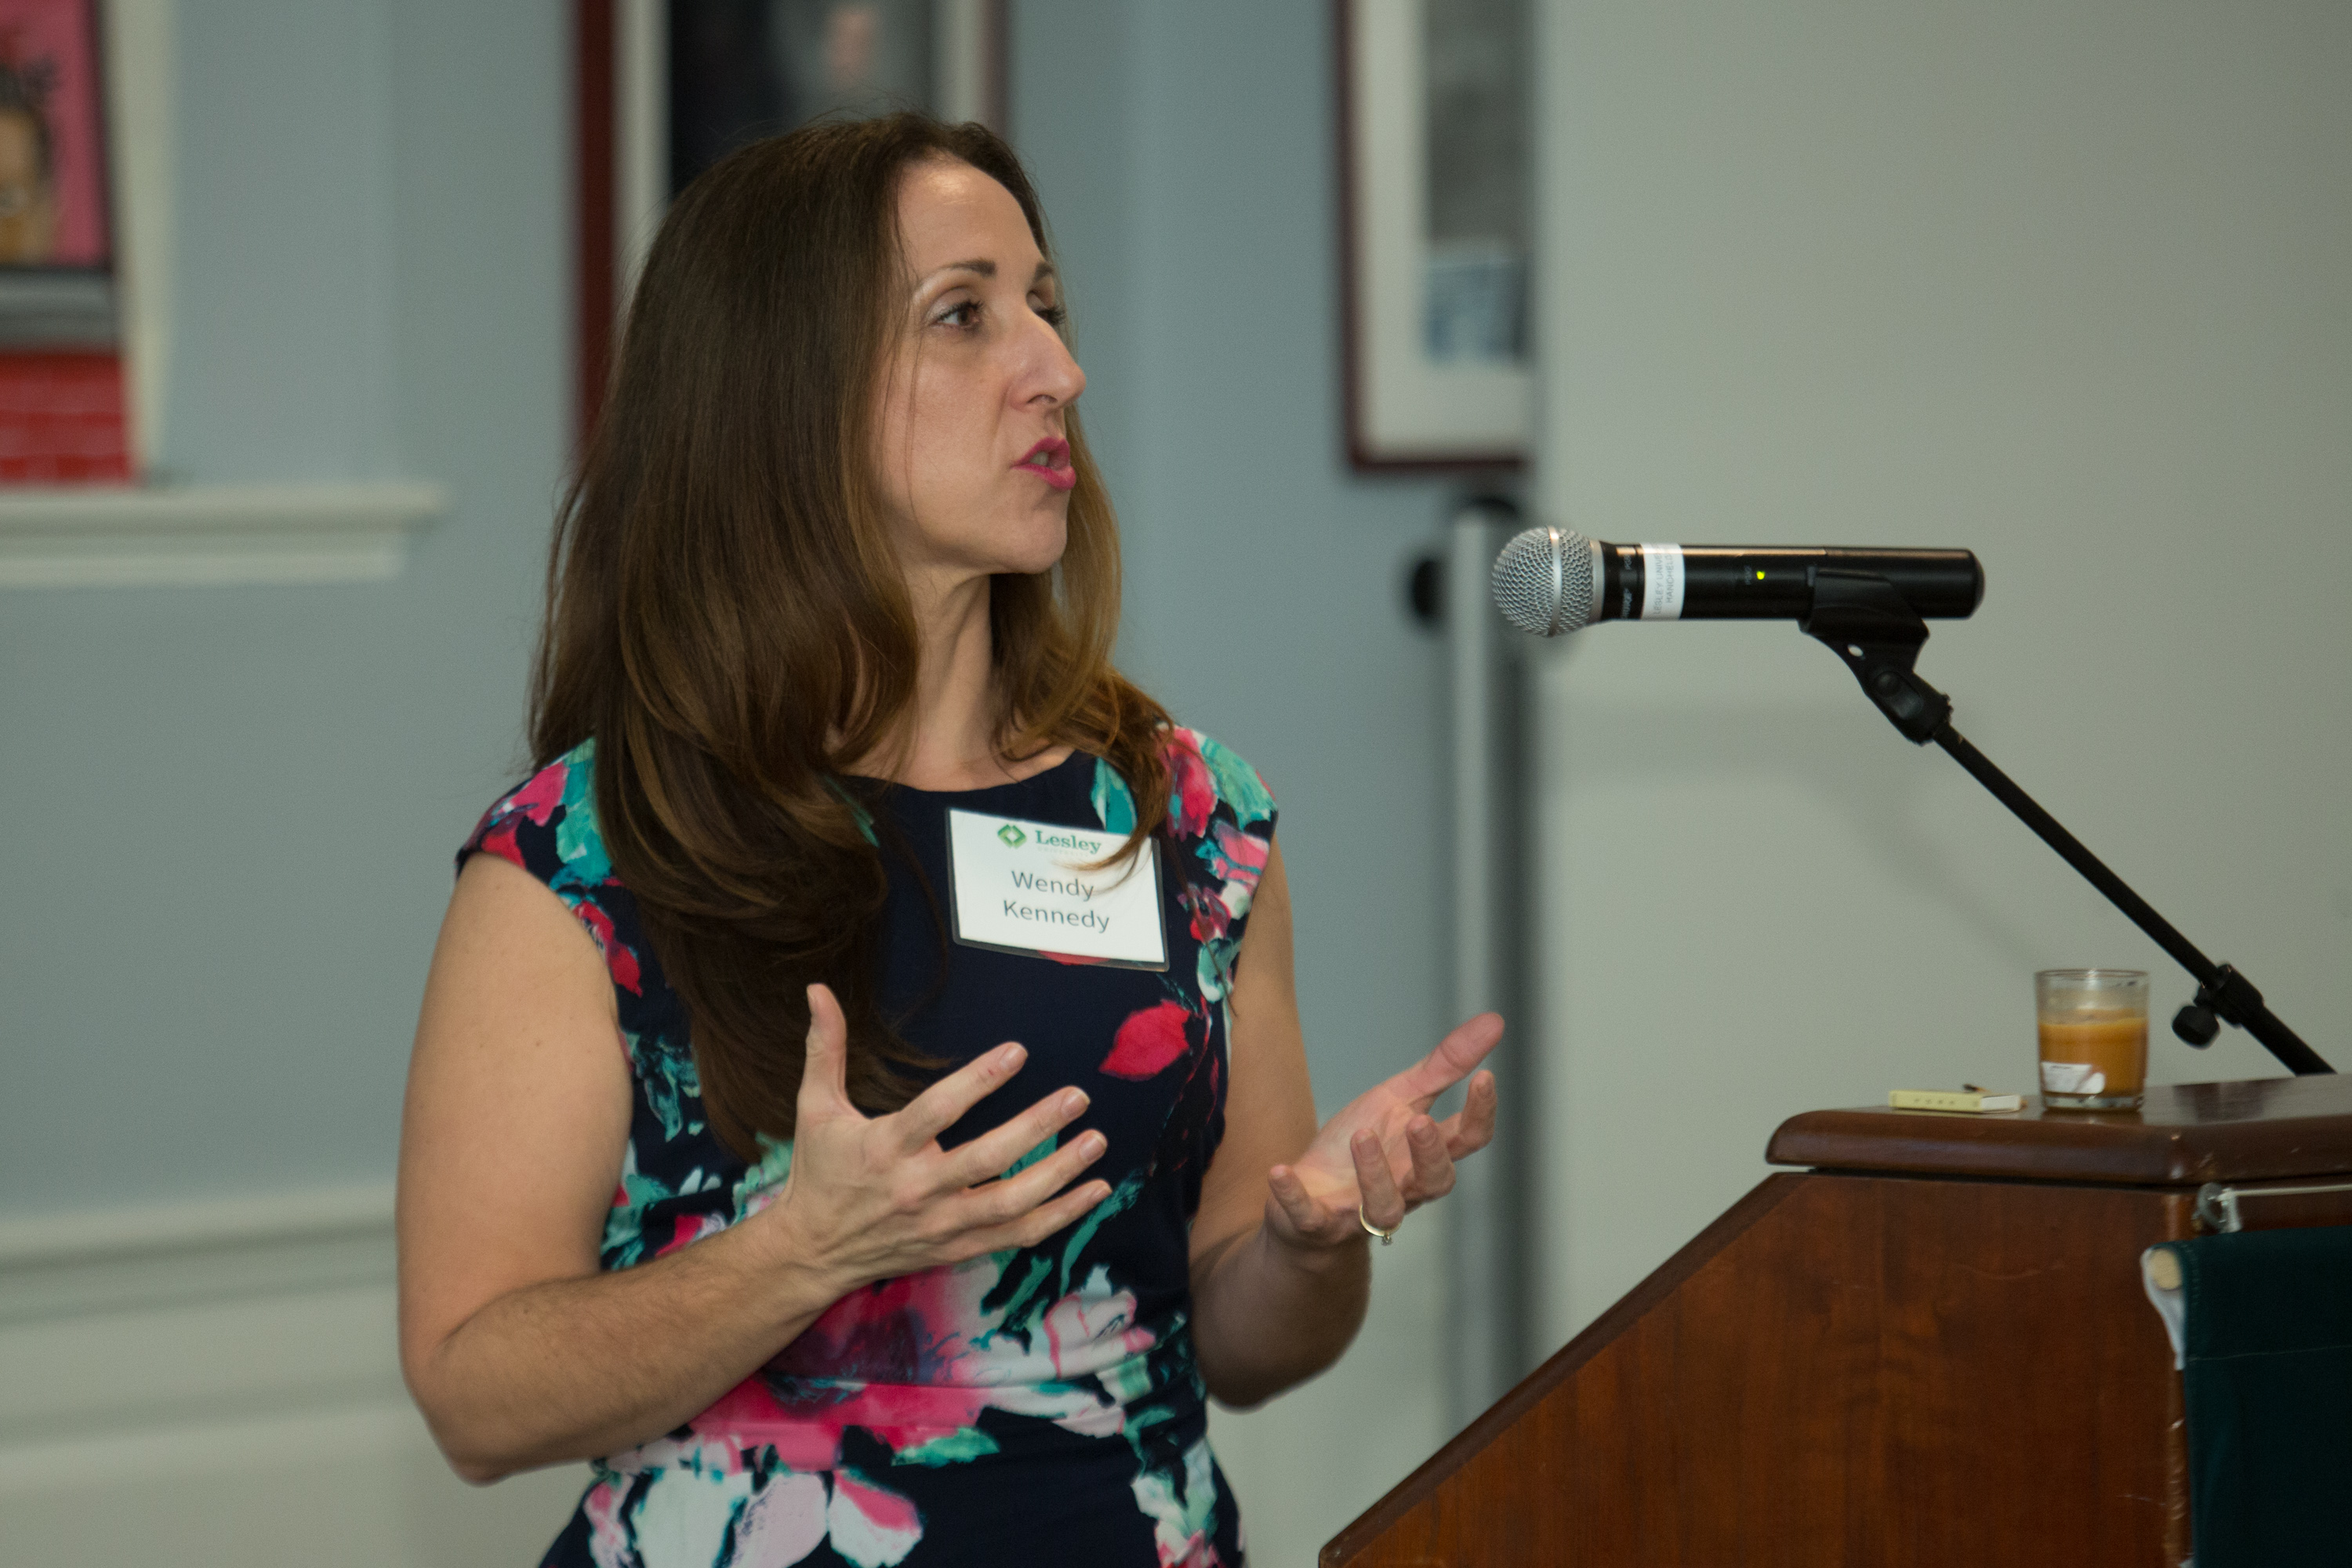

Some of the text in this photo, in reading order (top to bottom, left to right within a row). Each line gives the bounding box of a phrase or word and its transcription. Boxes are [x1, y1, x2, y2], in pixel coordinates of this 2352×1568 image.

[1035, 829, 1102, 855] Lesley
[1011, 870, 1094, 902] Wendy
[1003, 900, 1109, 933] Kennedy
